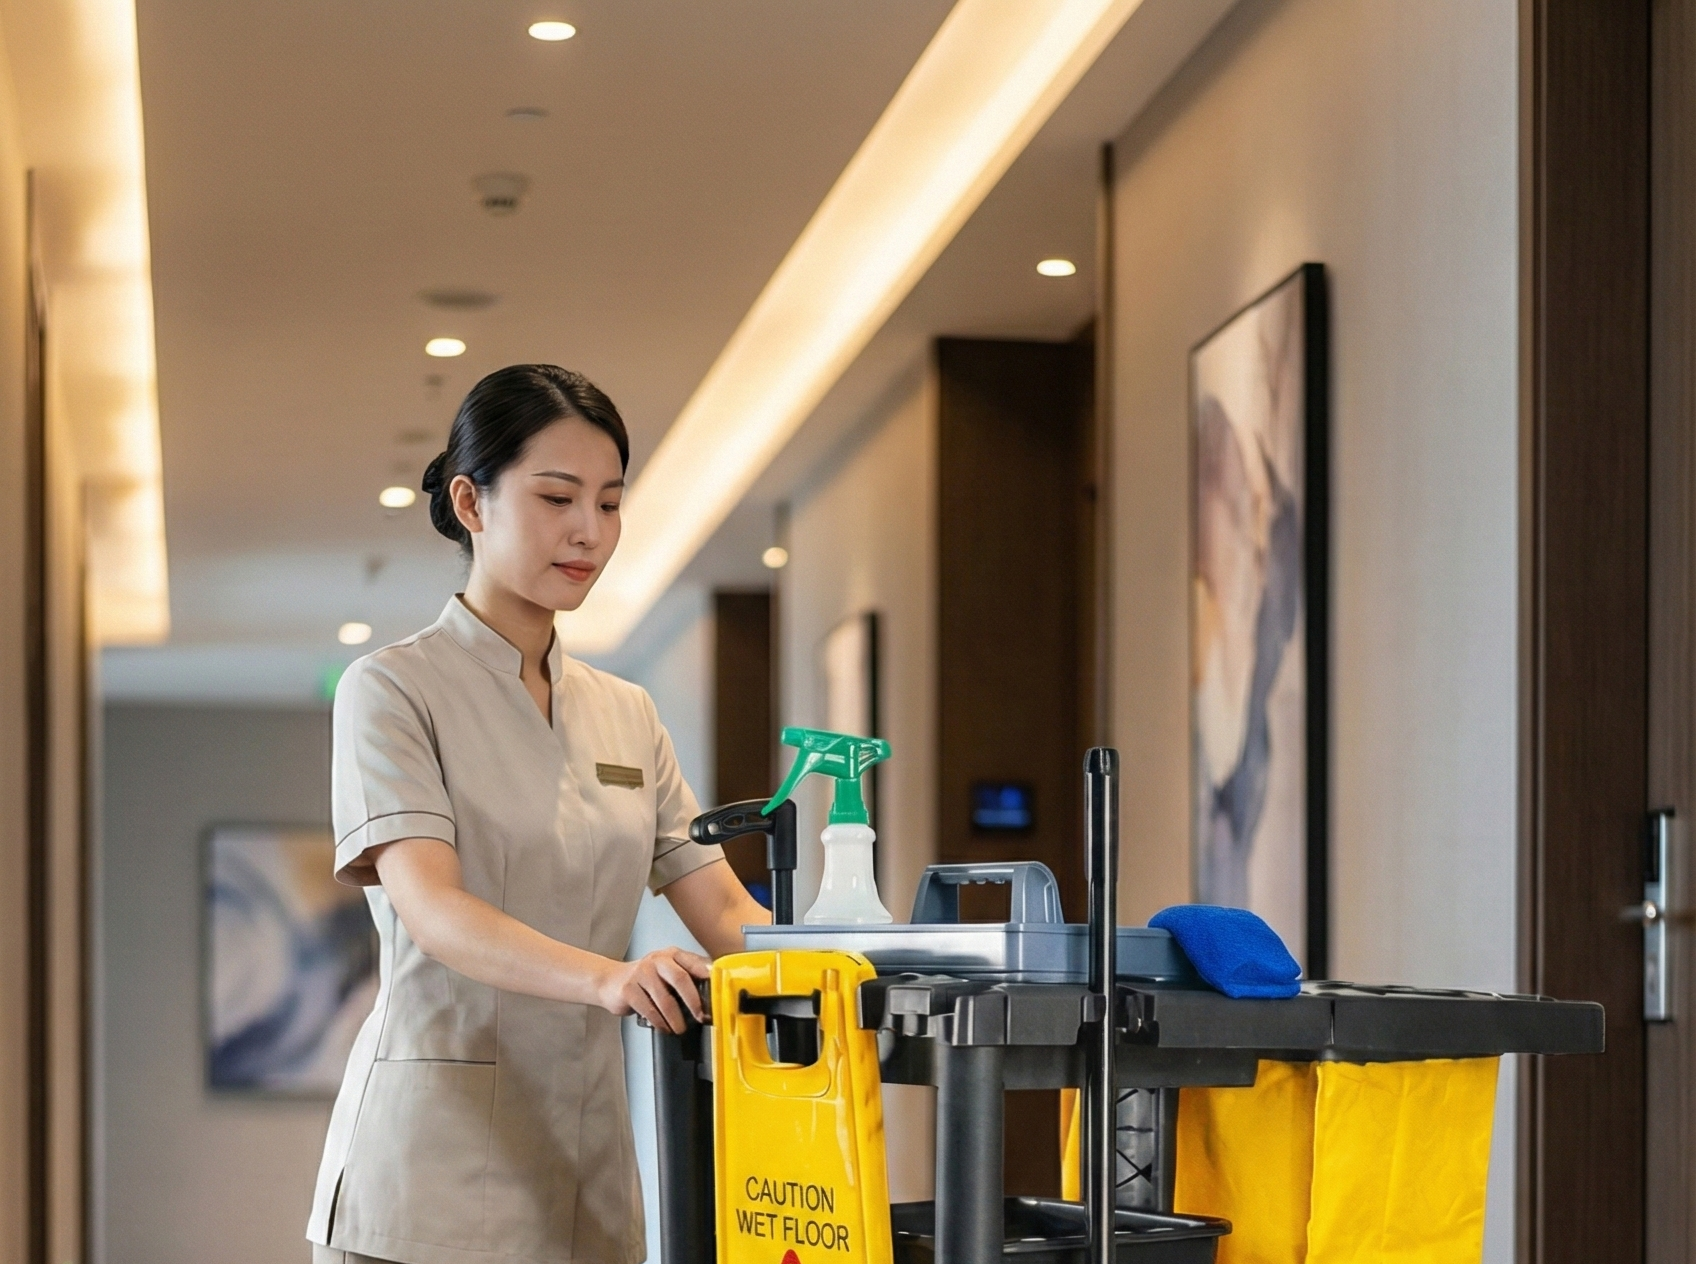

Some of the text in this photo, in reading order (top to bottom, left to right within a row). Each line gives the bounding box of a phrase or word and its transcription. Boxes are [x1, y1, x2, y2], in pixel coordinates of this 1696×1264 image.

[745, 1176, 834, 1214] CAUTION
[736, 1209, 850, 1252] WET FLOOR
